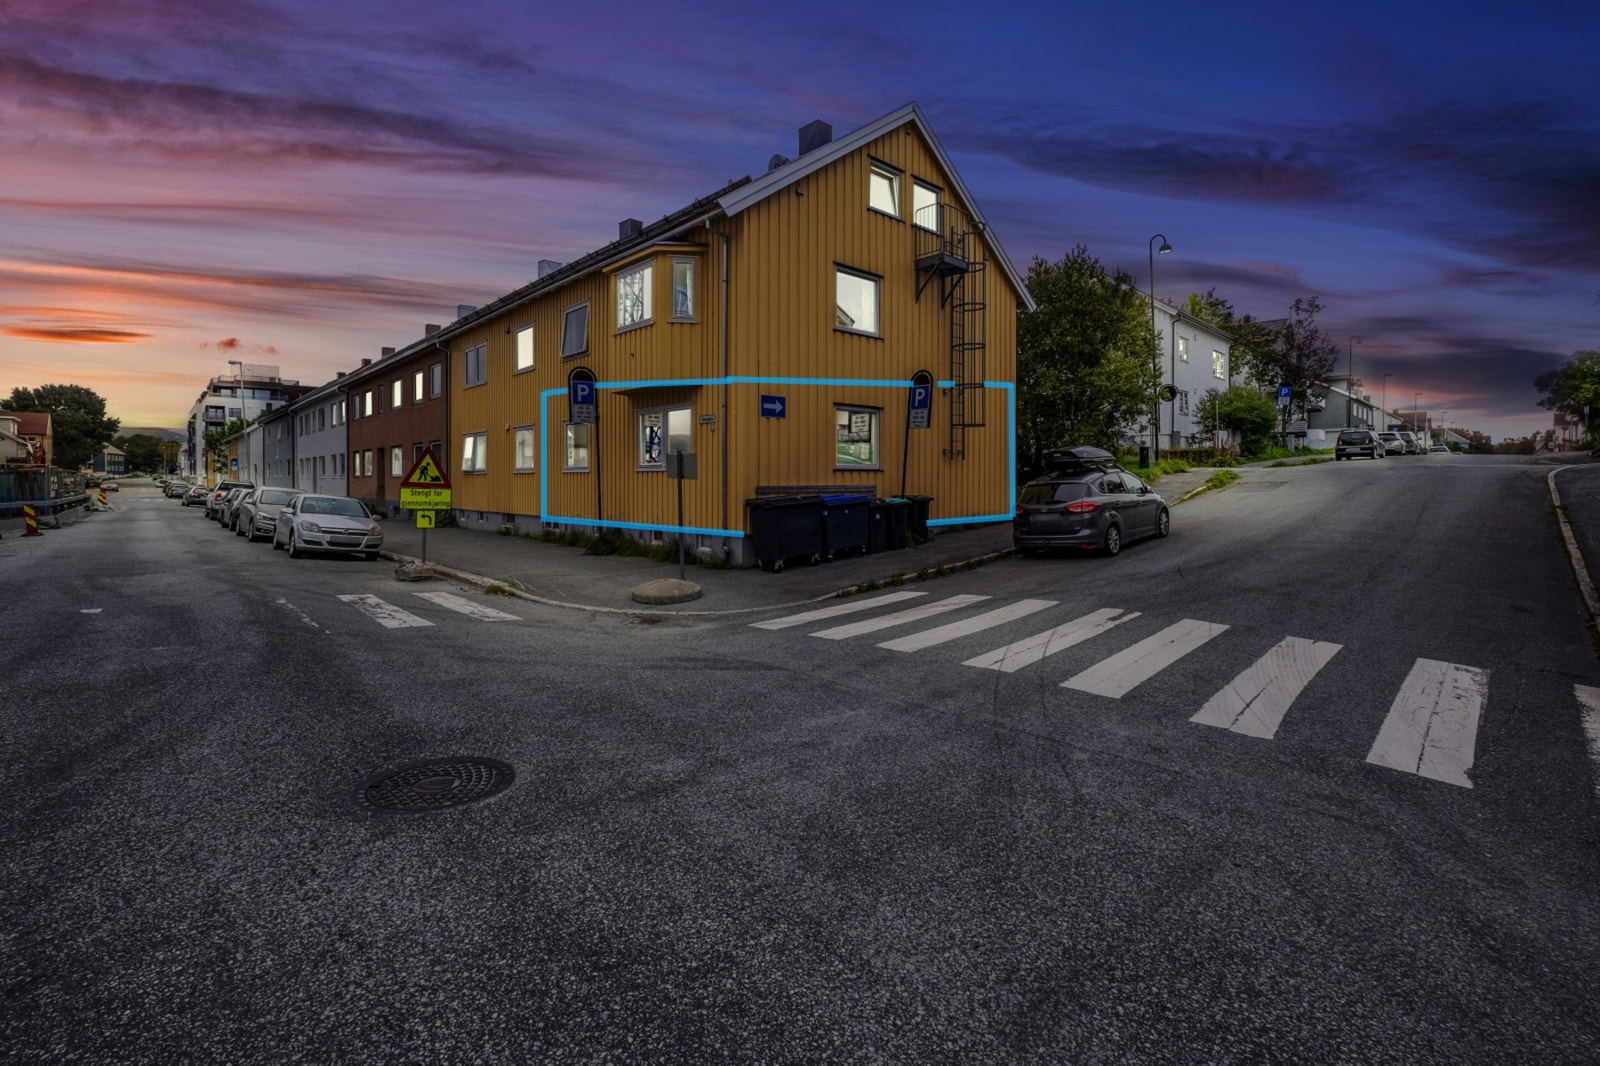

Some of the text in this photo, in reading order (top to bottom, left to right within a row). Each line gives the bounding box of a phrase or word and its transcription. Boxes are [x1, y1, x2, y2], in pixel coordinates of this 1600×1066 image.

[578, 384, 589, 402] P
[915, 388, 926, 406] P
[410, 490, 432, 498] Stengt
[402, 499, 450, 508] gjennomkjøring
